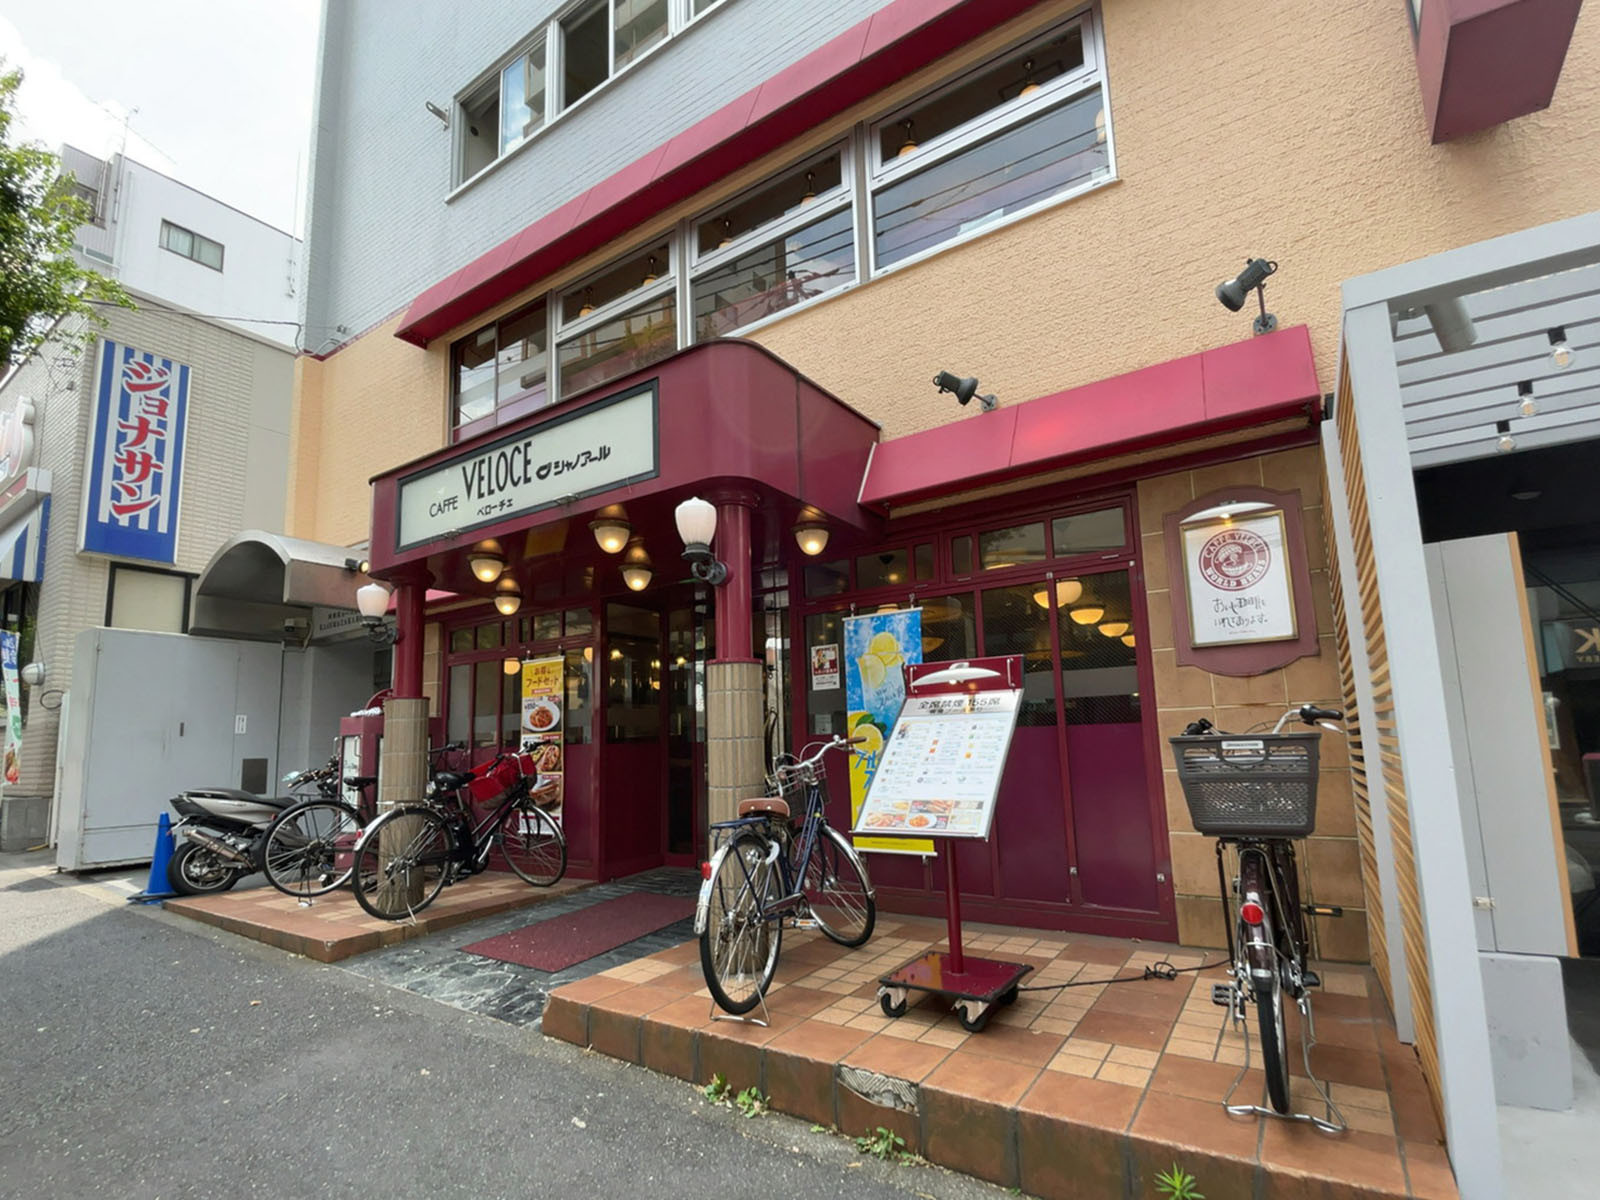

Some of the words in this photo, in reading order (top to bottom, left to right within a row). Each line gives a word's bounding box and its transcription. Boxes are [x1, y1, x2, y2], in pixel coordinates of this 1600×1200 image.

[112, 361, 170, 515] ジョナサン
[553, 444, 611, 476] シャノアール
[462, 440, 532, 501] VELOCE
[1205, 567, 1237, 587] WORLD
